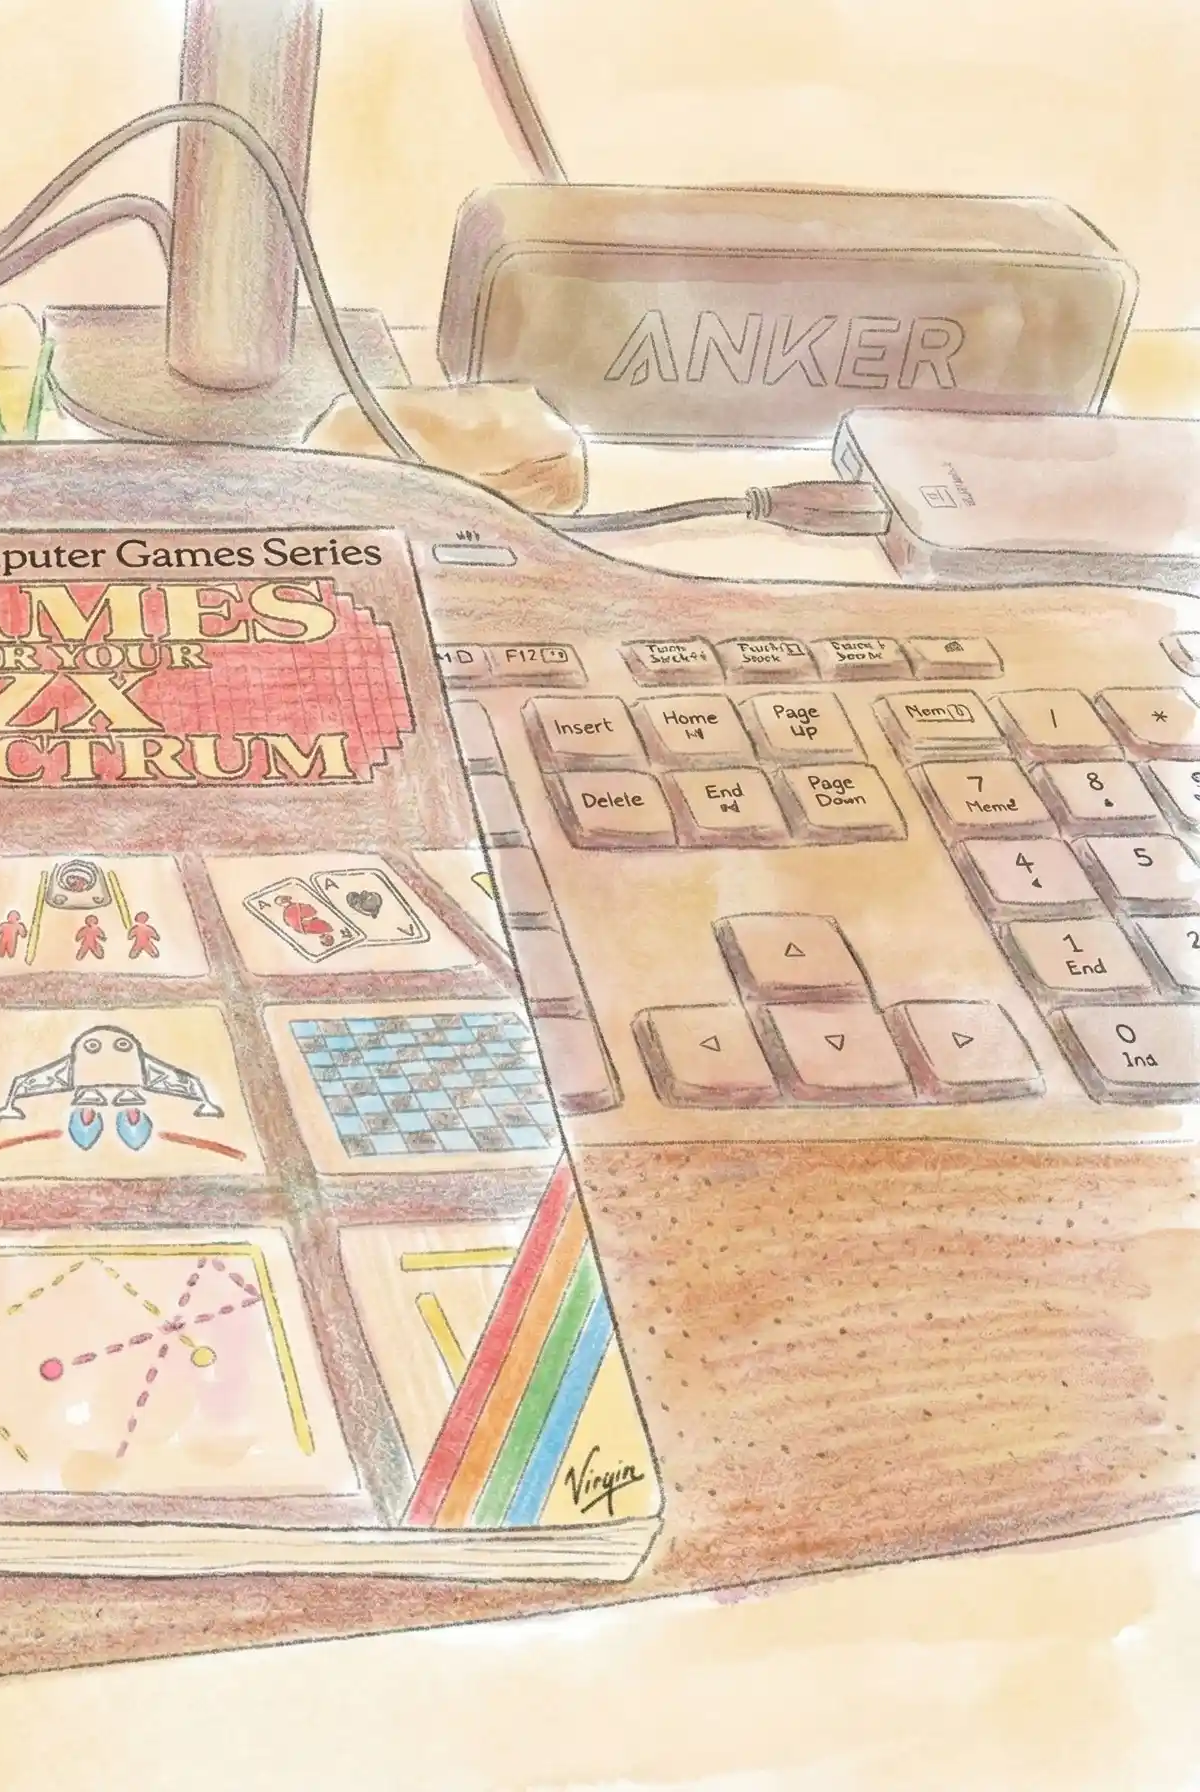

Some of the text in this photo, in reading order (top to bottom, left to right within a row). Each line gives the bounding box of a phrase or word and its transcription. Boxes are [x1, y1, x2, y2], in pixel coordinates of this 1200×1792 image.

[604, 309, 967, 390] ANKER
[117, 540, 254, 567] Games
[264, 538, 381, 566] Series
[55, 642, 212, 671] YOUR
[506, 649, 536, 662] F12
[663, 711, 718, 724] Home
[773, 705, 820, 722] Page
[555, 718, 613, 734] Insert
[808, 776, 854, 793] Page
[967, 776, 983, 792] 7
[1087, 773, 1104, 790] 8
[705, 783, 744, 798] End
[582, 792, 644, 808] Delete
[815, 792, 866, 807] Down
[1016, 853, 1034, 873] 4
[1134, 848, 1153, 866] 5
[1063, 934, 1083, 952] 1
[1066, 958, 1107, 975] End
[564, 1446, 644, 1516] Virgin
